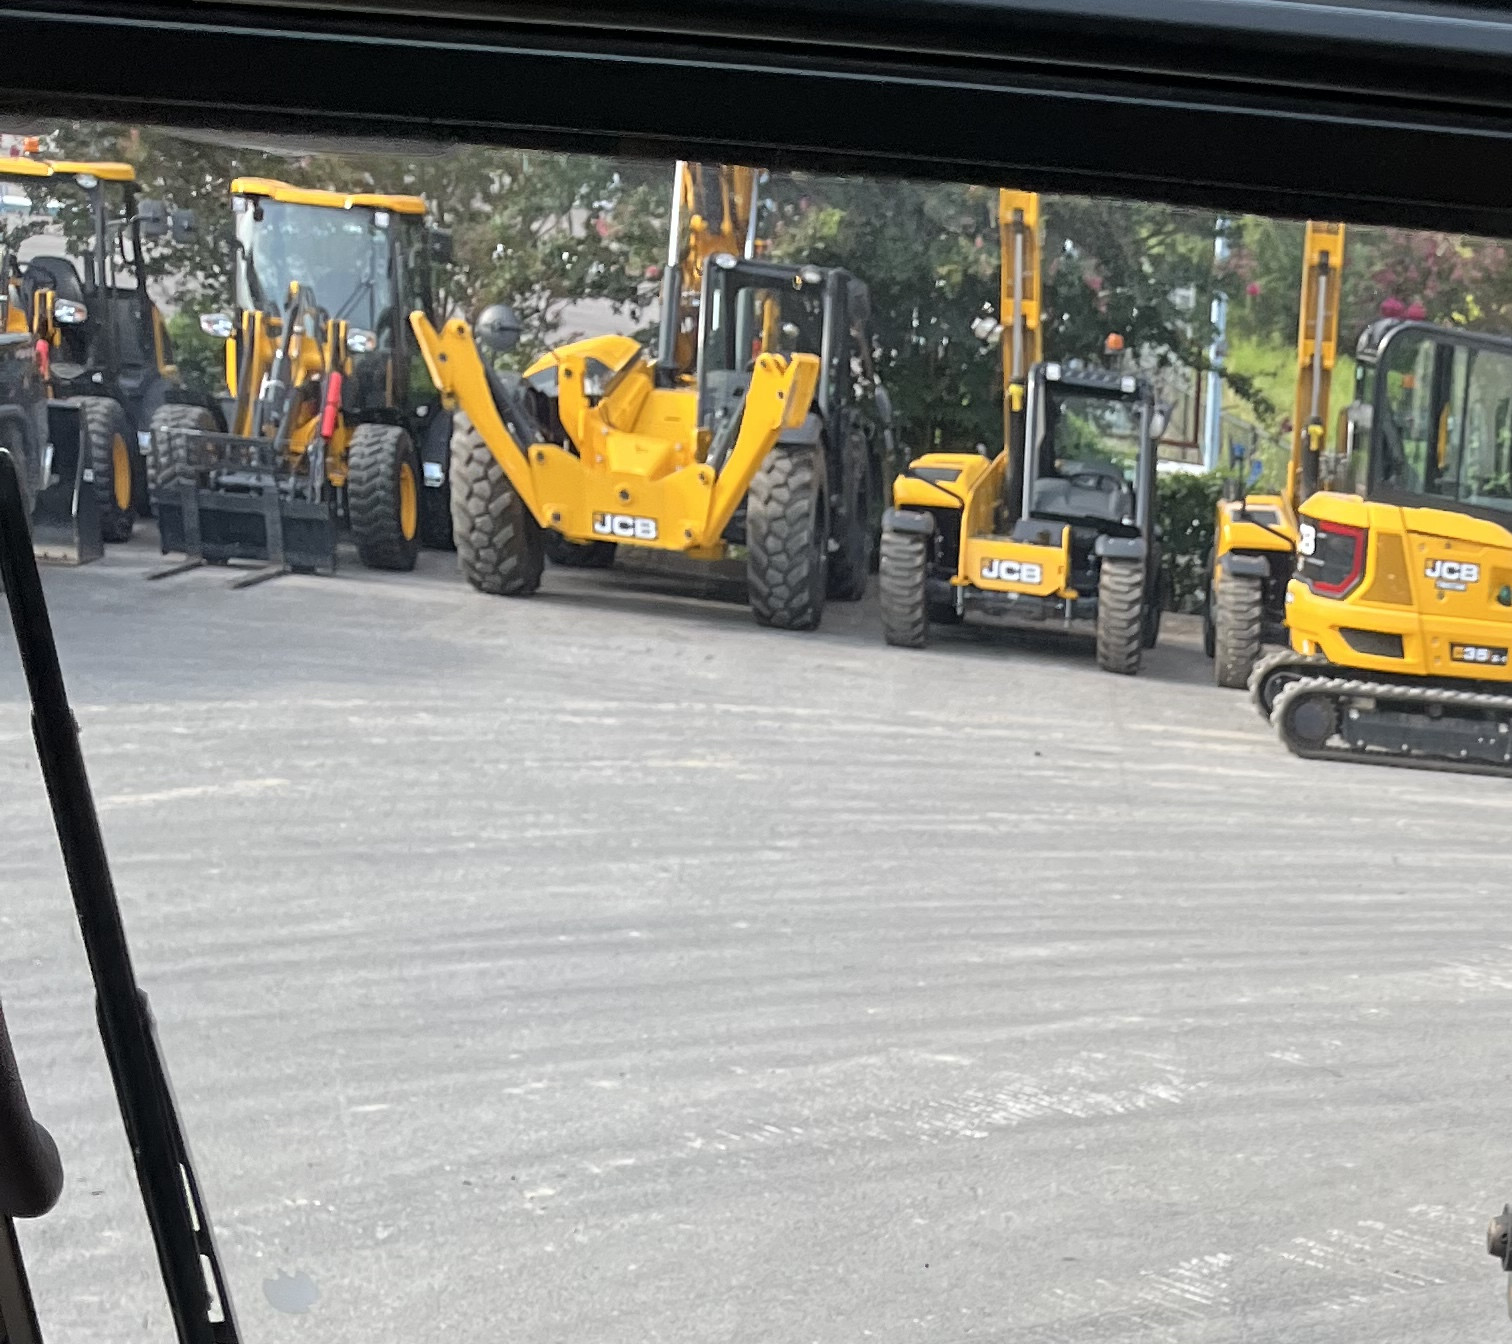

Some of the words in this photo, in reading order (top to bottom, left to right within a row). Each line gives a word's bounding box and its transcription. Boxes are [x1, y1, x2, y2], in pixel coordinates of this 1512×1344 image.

[593, 514, 657, 540] JCB
[981, 559, 1042, 585] JCB
[1424, 560, 1479, 582] JCB
